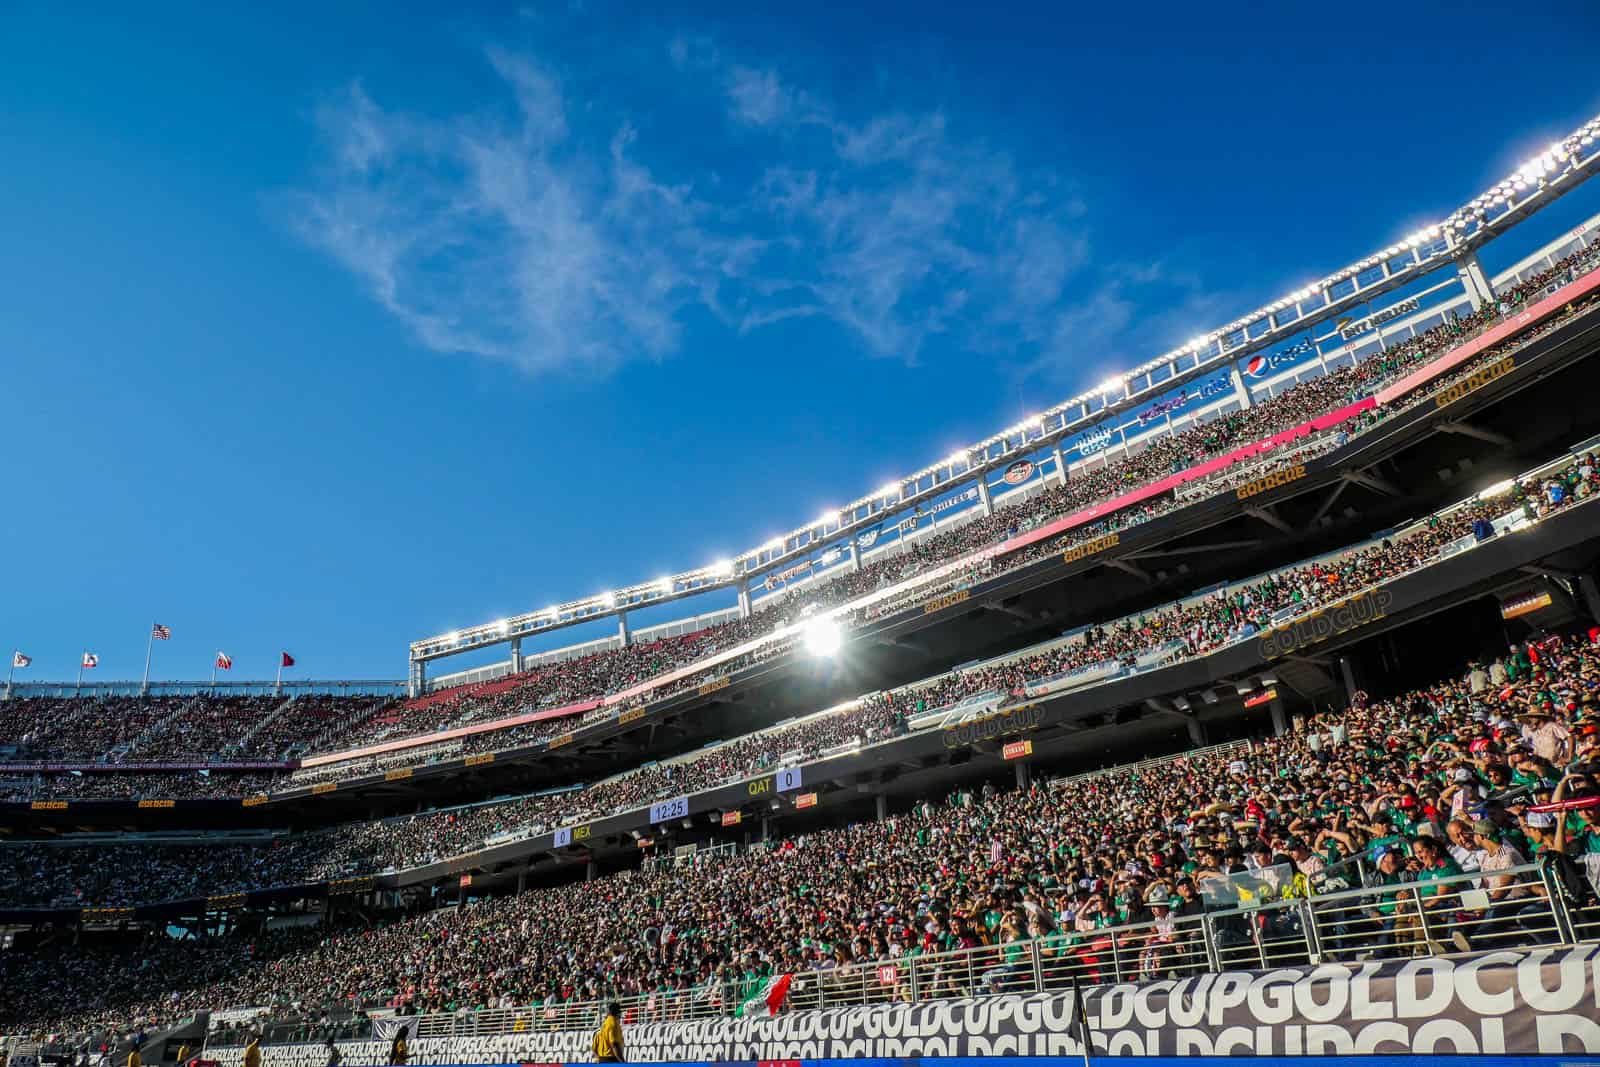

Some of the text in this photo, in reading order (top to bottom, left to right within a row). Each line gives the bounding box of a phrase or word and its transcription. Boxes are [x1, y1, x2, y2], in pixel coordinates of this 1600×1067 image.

[1236, 465, 1307, 500] GOLDCUP
[1064, 534, 1120, 564] GOLDCUP
[748, 773, 793, 795] QAT 0
[655, 800, 683, 819] 12:25
[573, 827, 591, 841] MEX
[882, 968, 894, 982] 121
